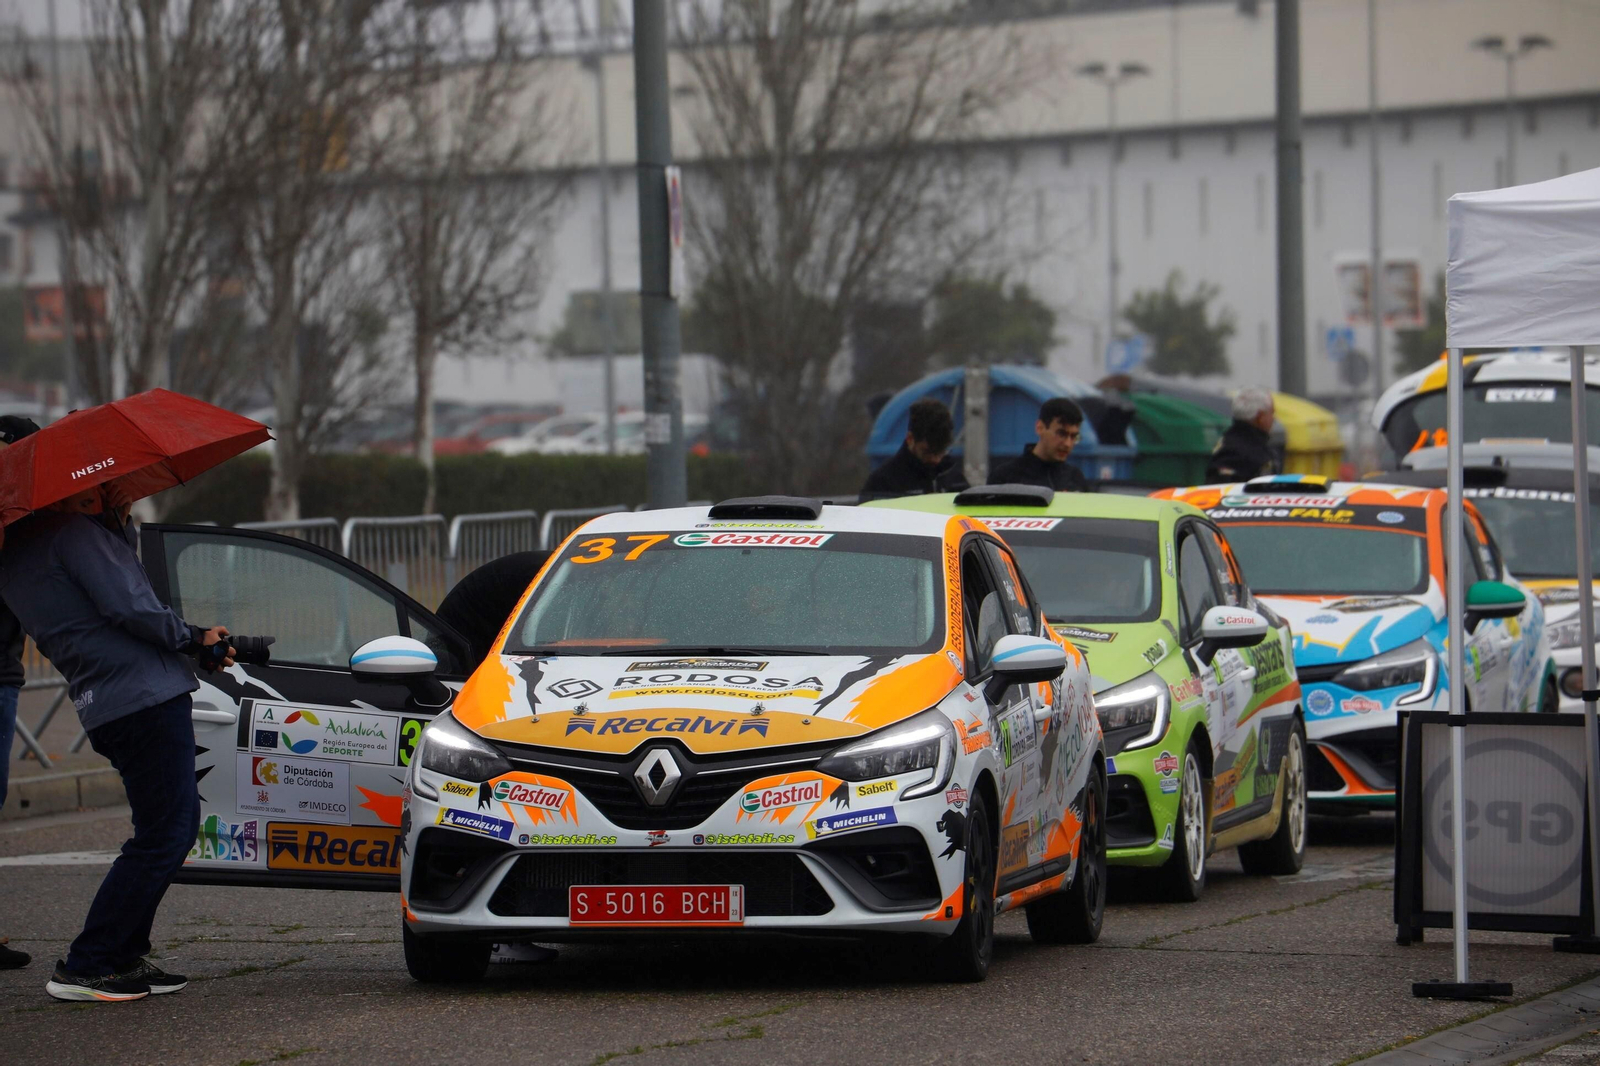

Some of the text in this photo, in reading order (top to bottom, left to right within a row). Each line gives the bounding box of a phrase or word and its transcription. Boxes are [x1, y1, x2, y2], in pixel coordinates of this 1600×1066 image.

[71, 457, 115, 479] INESIS
[1250, 495, 1340, 507] Castrol
[711, 533, 825, 546] Castrol
[570, 534, 670, 564] 37
[946, 543, 962, 653] ESCUDERIA OURENSE
[1226, 616, 1255, 624] Castrol
[614, 674, 824, 688] RODOSA
[635, 689, 793, 699] www.rodosa.com
[324, 718, 388, 740] Andalucía
[597, 716, 738, 736] Recalvi
[323, 739, 346, 747] Región
[347, 741, 375, 750] Europea
[322, 747, 364, 757] DEPORTE
[284, 765, 333, 779] Diputación
[283, 776, 334, 789] de Córdoba
[442, 782, 474, 797] Sabelt
[858, 781, 894, 797] Sabelt
[508, 784, 565, 808] Castrol
[761, 782, 820, 808] Castrol
[309, 801, 347, 812] IMDECO
[454, 815, 503, 833] MICHELIN
[833, 813, 887, 829] MICHELIN
[530, 833, 618, 846] @isdetail.es
[705, 833, 796, 845] @isdetail.es
[576, 892, 725, 914] S 5016 BCH
